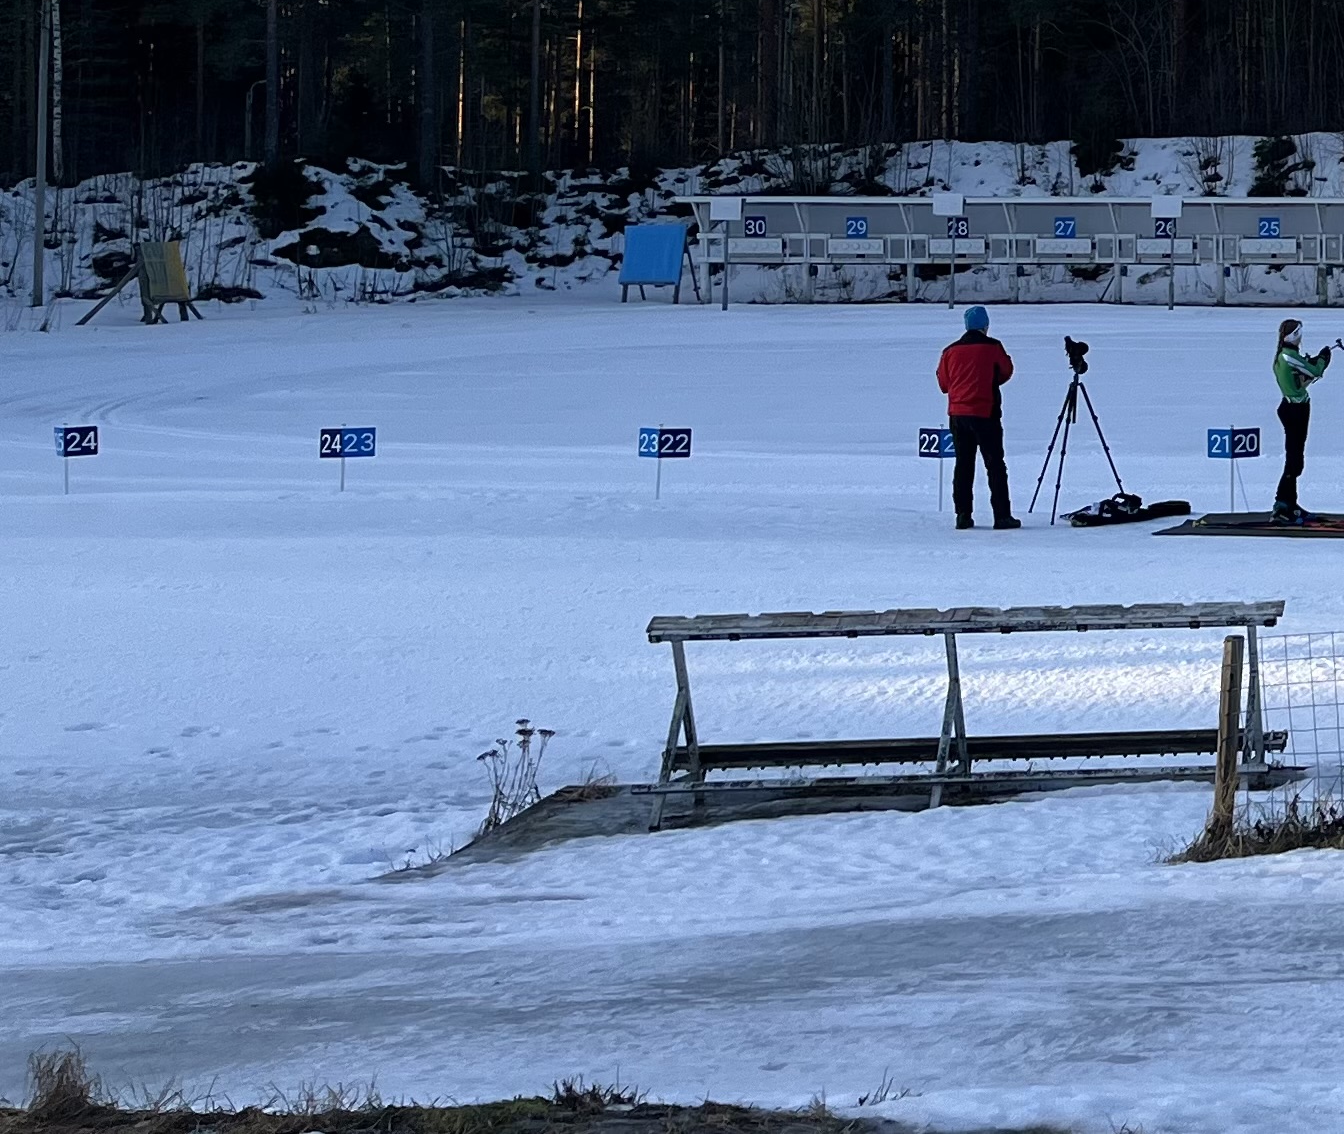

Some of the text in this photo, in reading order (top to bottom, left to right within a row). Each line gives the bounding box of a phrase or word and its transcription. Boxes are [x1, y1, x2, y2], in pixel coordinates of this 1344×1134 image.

[745, 220, 766, 235] 30
[846, 220, 867, 235] 29
[948, 221, 968, 236] 28
[1055, 221, 1075, 236] 27
[1155, 221, 1175, 236] 26
[1259, 221, 1280, 236] 25
[66, 431, 97, 452] 24
[321, 433, 341, 454] 24
[343, 432, 374, 452] 23
[639, 433, 659, 453] 23
[660, 433, 689, 453] 22
[919, 433, 939, 453] 22
[943, 433, 955, 453] 2
[1211, 434, 1230, 453] 21
[1234, 433, 1258, 453] 20
